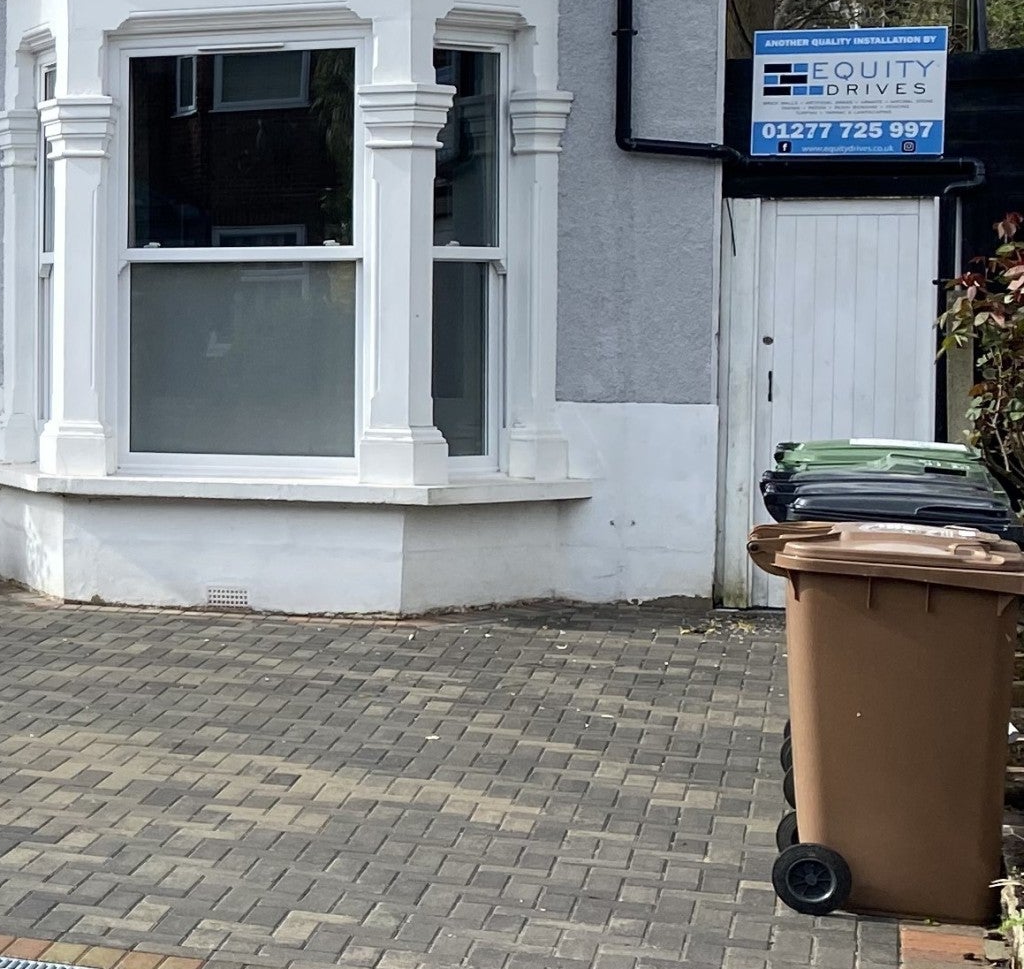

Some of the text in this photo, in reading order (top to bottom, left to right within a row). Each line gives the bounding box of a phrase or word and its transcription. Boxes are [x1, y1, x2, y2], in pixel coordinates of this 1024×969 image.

[765, 35, 937, 47] ANOTHER QUALITY INSTALLATION BY
[812, 60, 935, 81] EQUITY
[826, 83, 926, 96] DRIVES
[762, 121, 933, 139] 01277 725 997
[801, 144, 894, 153] www.equitydrives.co.uk
